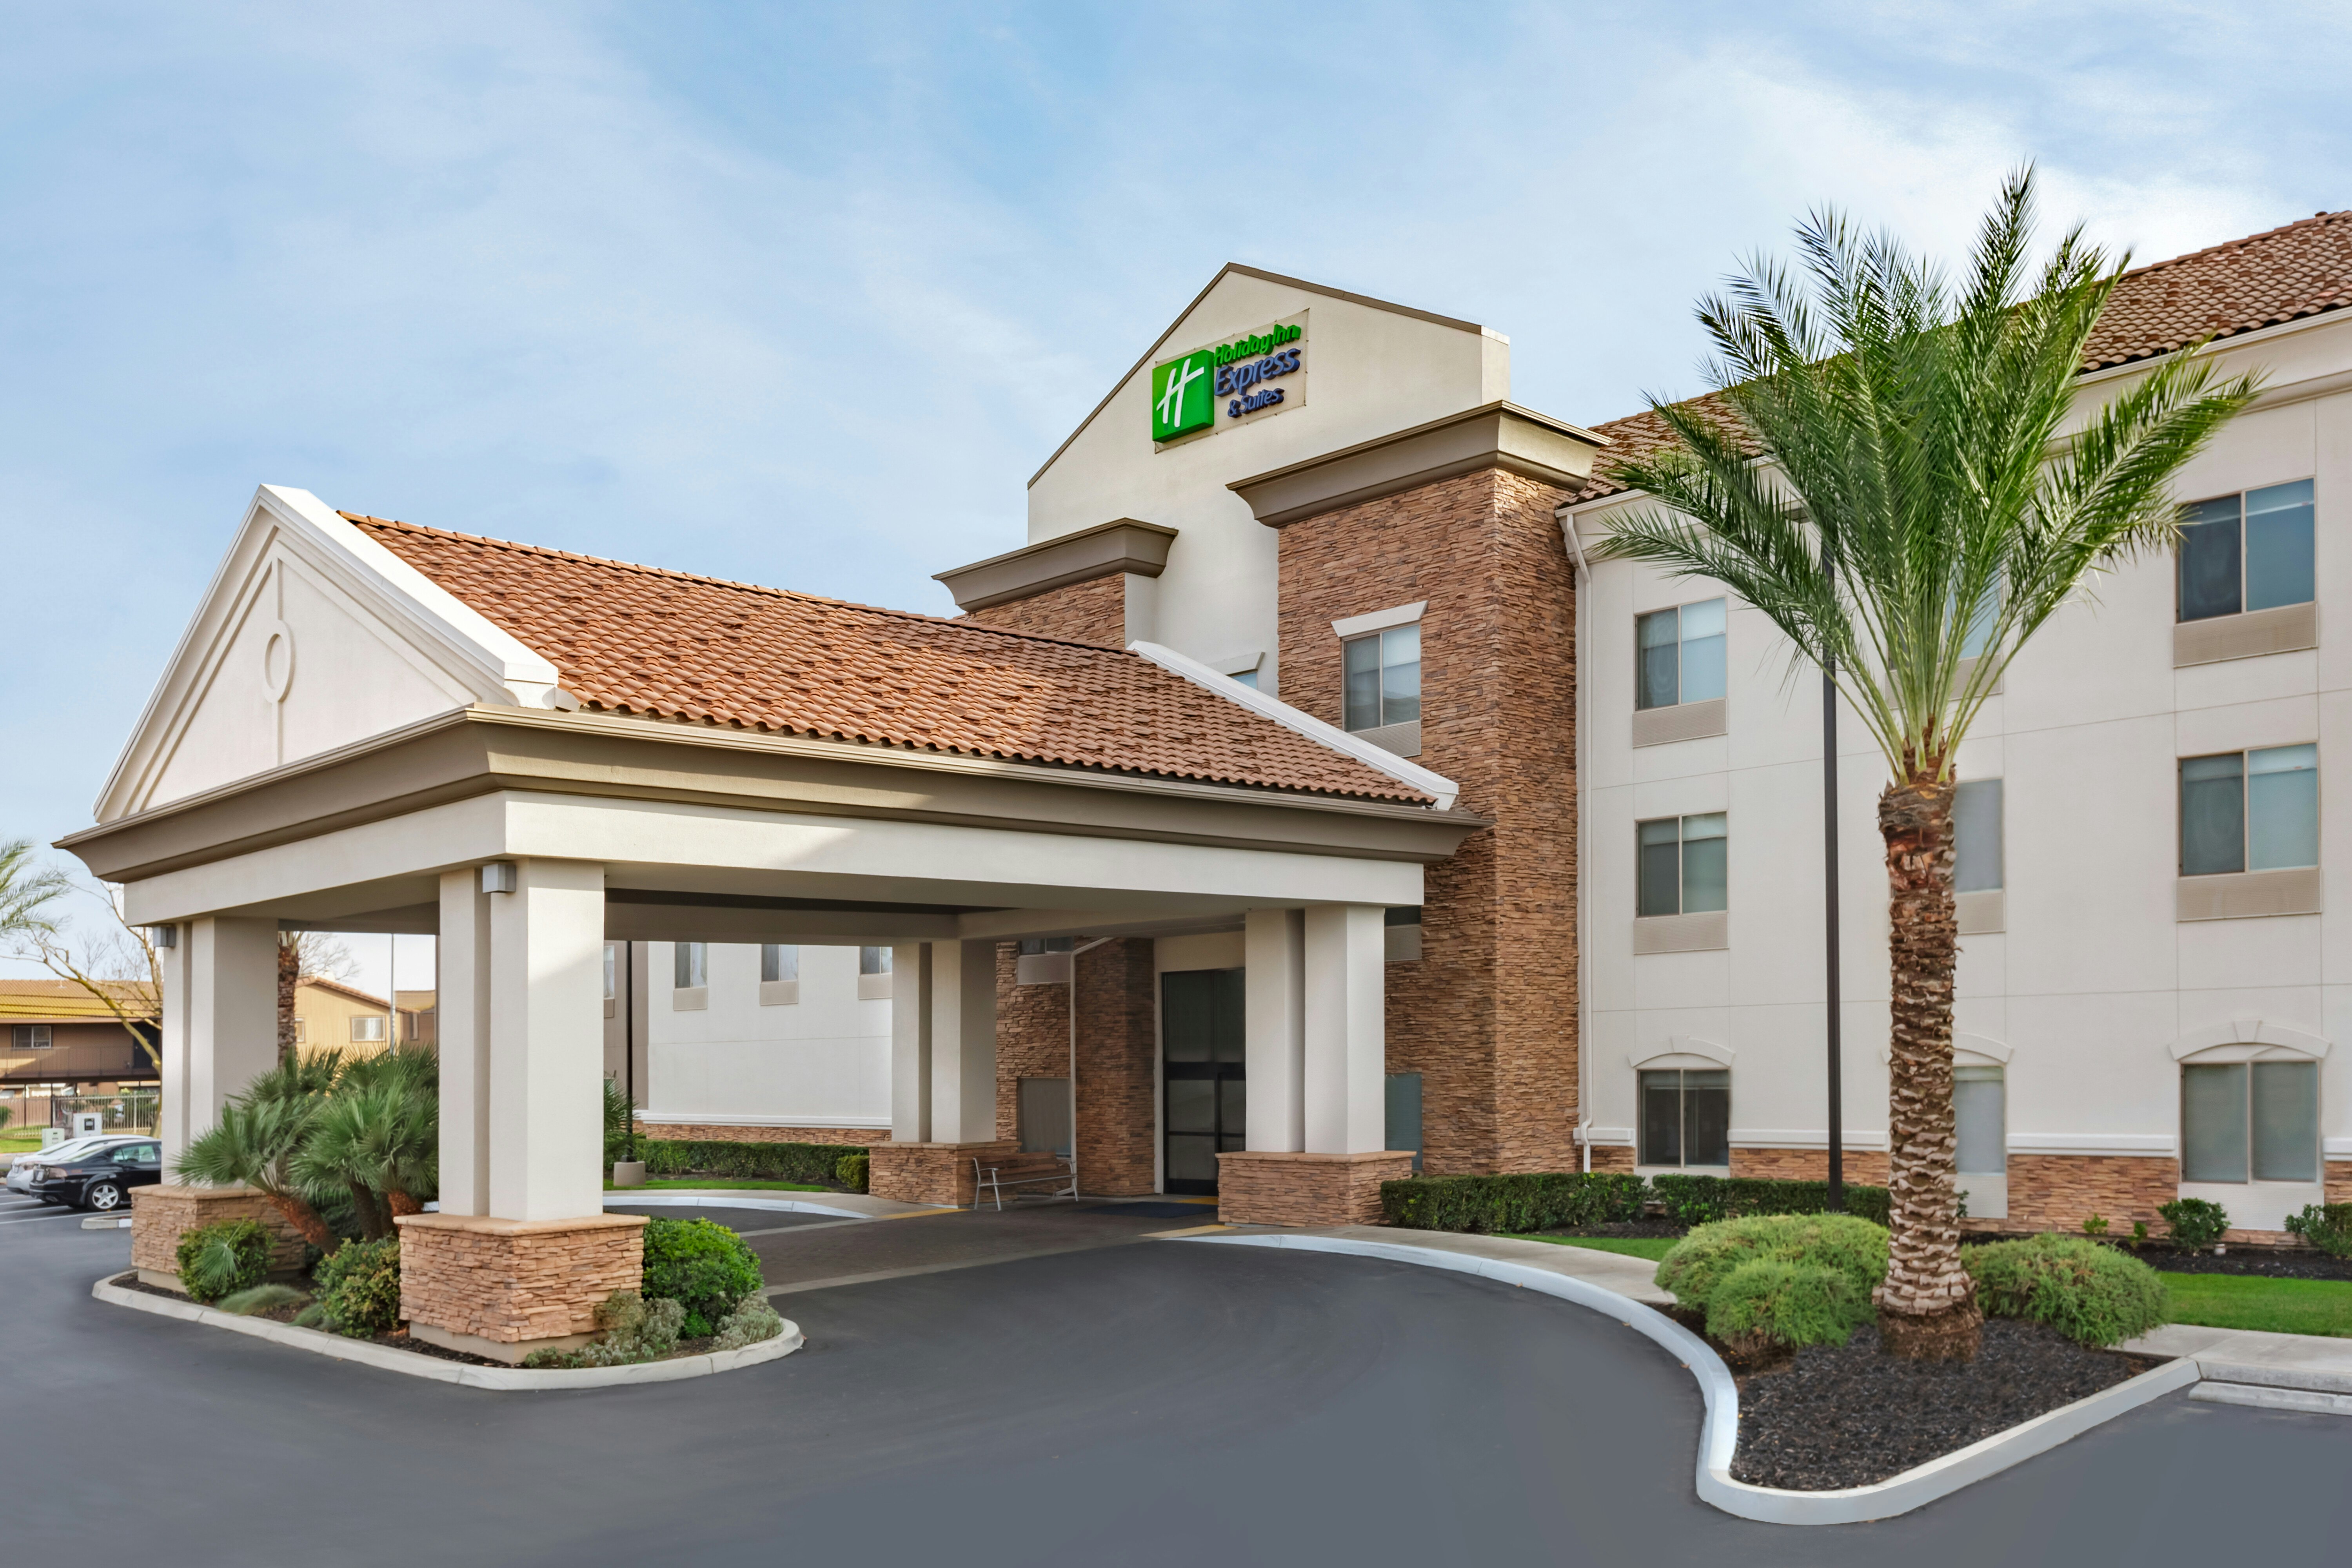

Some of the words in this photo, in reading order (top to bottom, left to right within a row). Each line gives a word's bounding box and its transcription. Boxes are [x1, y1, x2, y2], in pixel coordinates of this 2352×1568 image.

[1214, 334, 1274, 367] Holiday
[1272, 324, 1301, 346] Inn
[1214, 348, 1301, 397] Express
[1228, 399, 1242, 418] &
[1240, 388, 1285, 414] Suites
